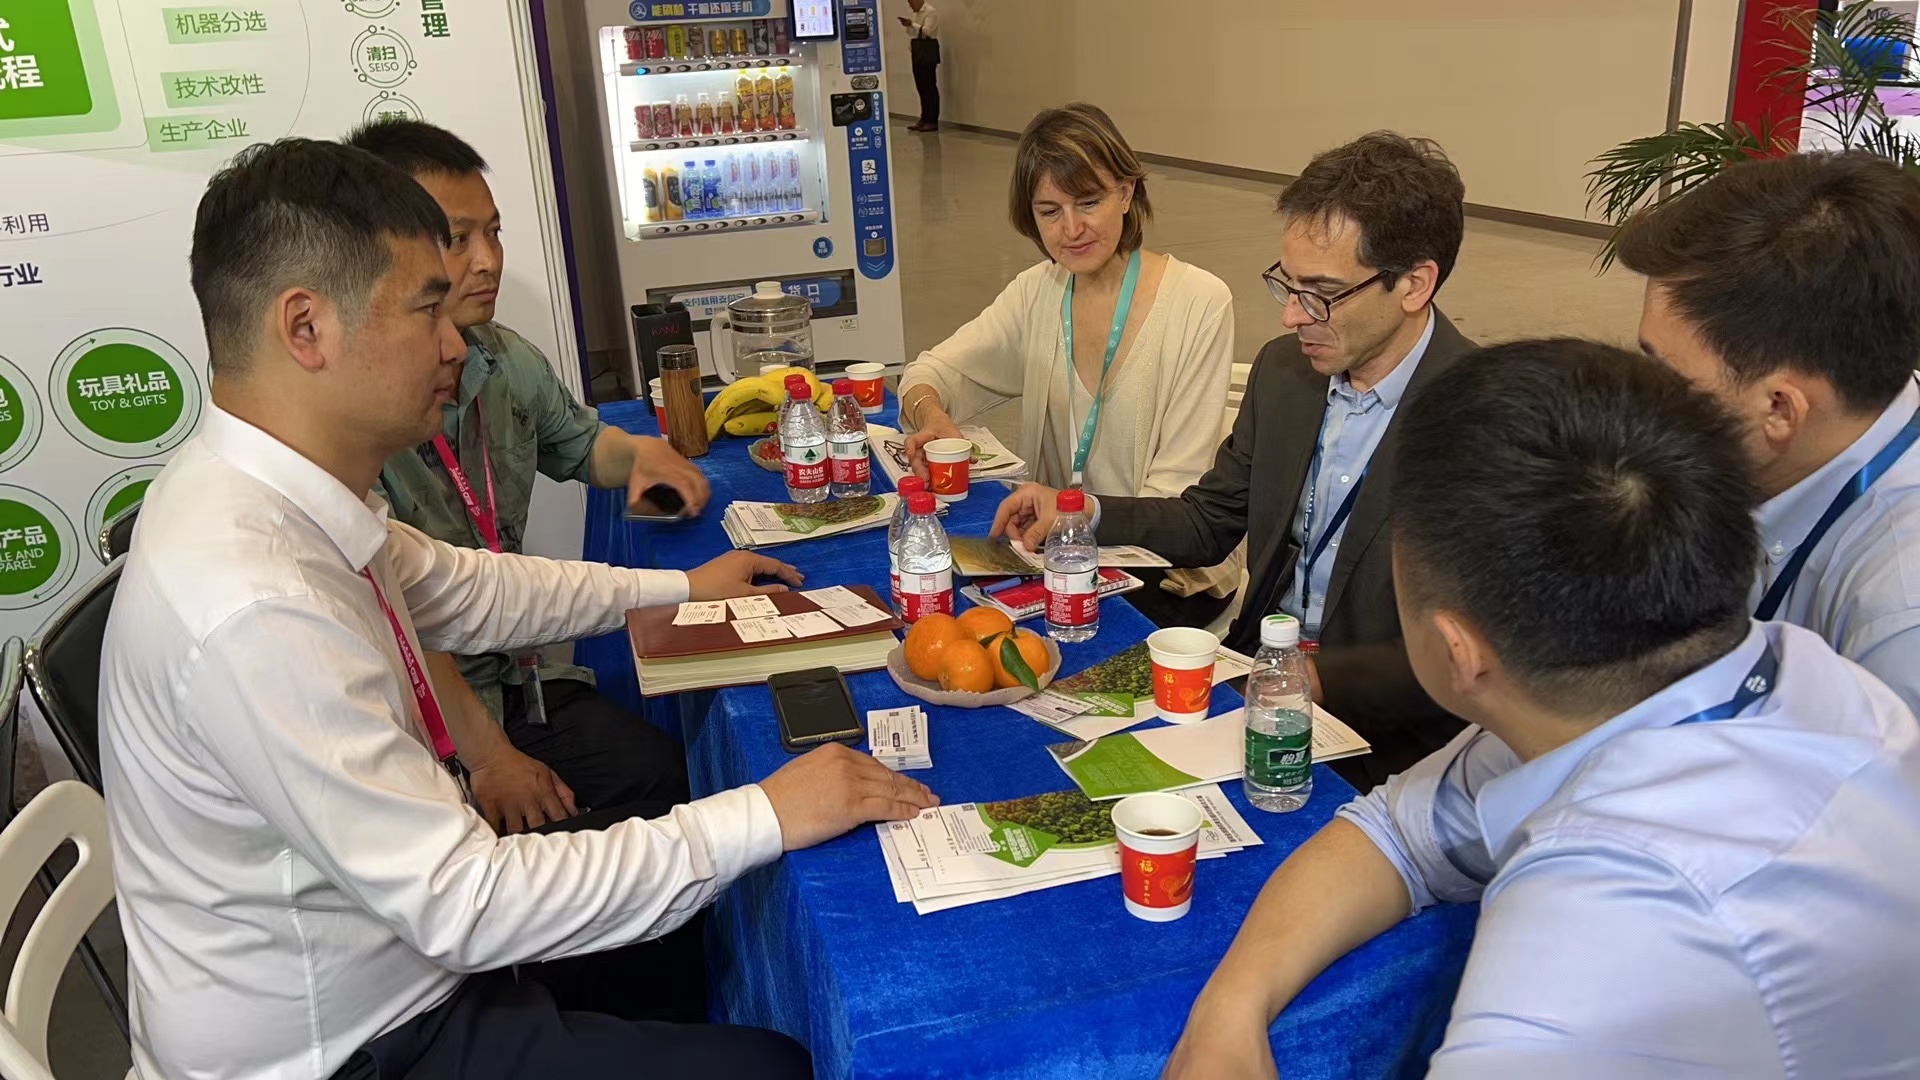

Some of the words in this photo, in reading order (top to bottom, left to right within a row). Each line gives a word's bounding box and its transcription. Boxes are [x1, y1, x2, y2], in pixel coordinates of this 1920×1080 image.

[175, 10, 267, 36] 机器分选
[367, 46, 397, 61] 清扫
[0, 54, 44, 90] 程
[368, 62, 399, 72] SEISO
[175, 73, 266, 99] 技术改性
[159, 119, 250, 143] 生产企业
[77, 370, 171, 398] 玩具礼品
[90, 399, 116, 412] TOY
[119, 397, 131, 409] &
[133, 394, 167, 407] GIFTS
[798, 466, 824, 476] 农夫山泉
[855, 461, 869, 471] 农夫
[16, 548, 44, 561] AND
[1139, 859, 1153, 873] 福
